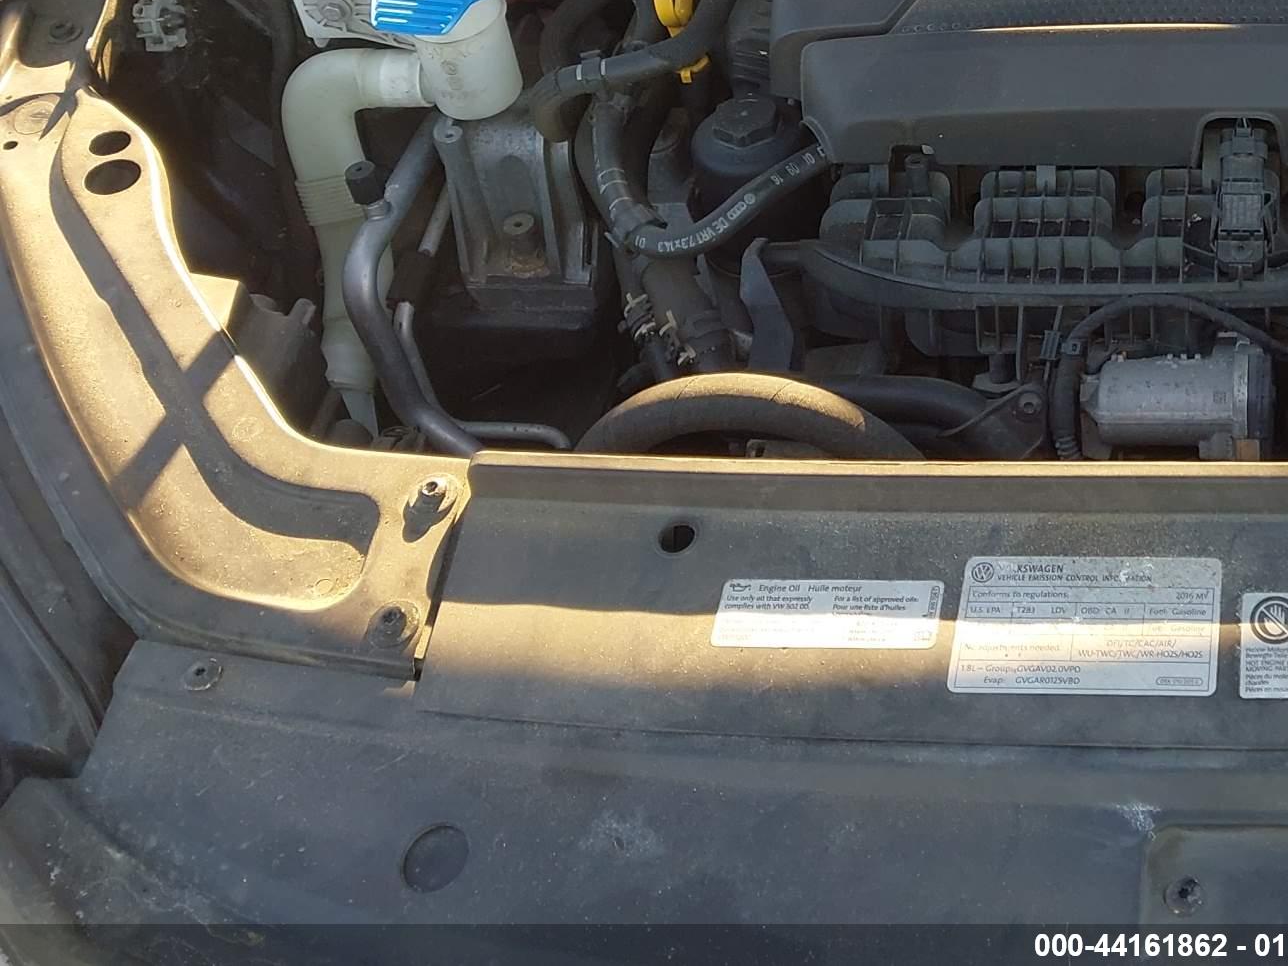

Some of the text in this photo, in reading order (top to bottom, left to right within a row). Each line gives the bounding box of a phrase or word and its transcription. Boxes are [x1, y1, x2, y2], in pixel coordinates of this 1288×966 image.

[714, 217, 728, 234] DE
[697, 230, 716, 245] VRT
[1028, 574, 1063, 582] EMISSION
[759, 584, 801, 594] Engine Oil
[808, 584, 829, 592] Huile
[972, 590, 1010, 599] Conforms
